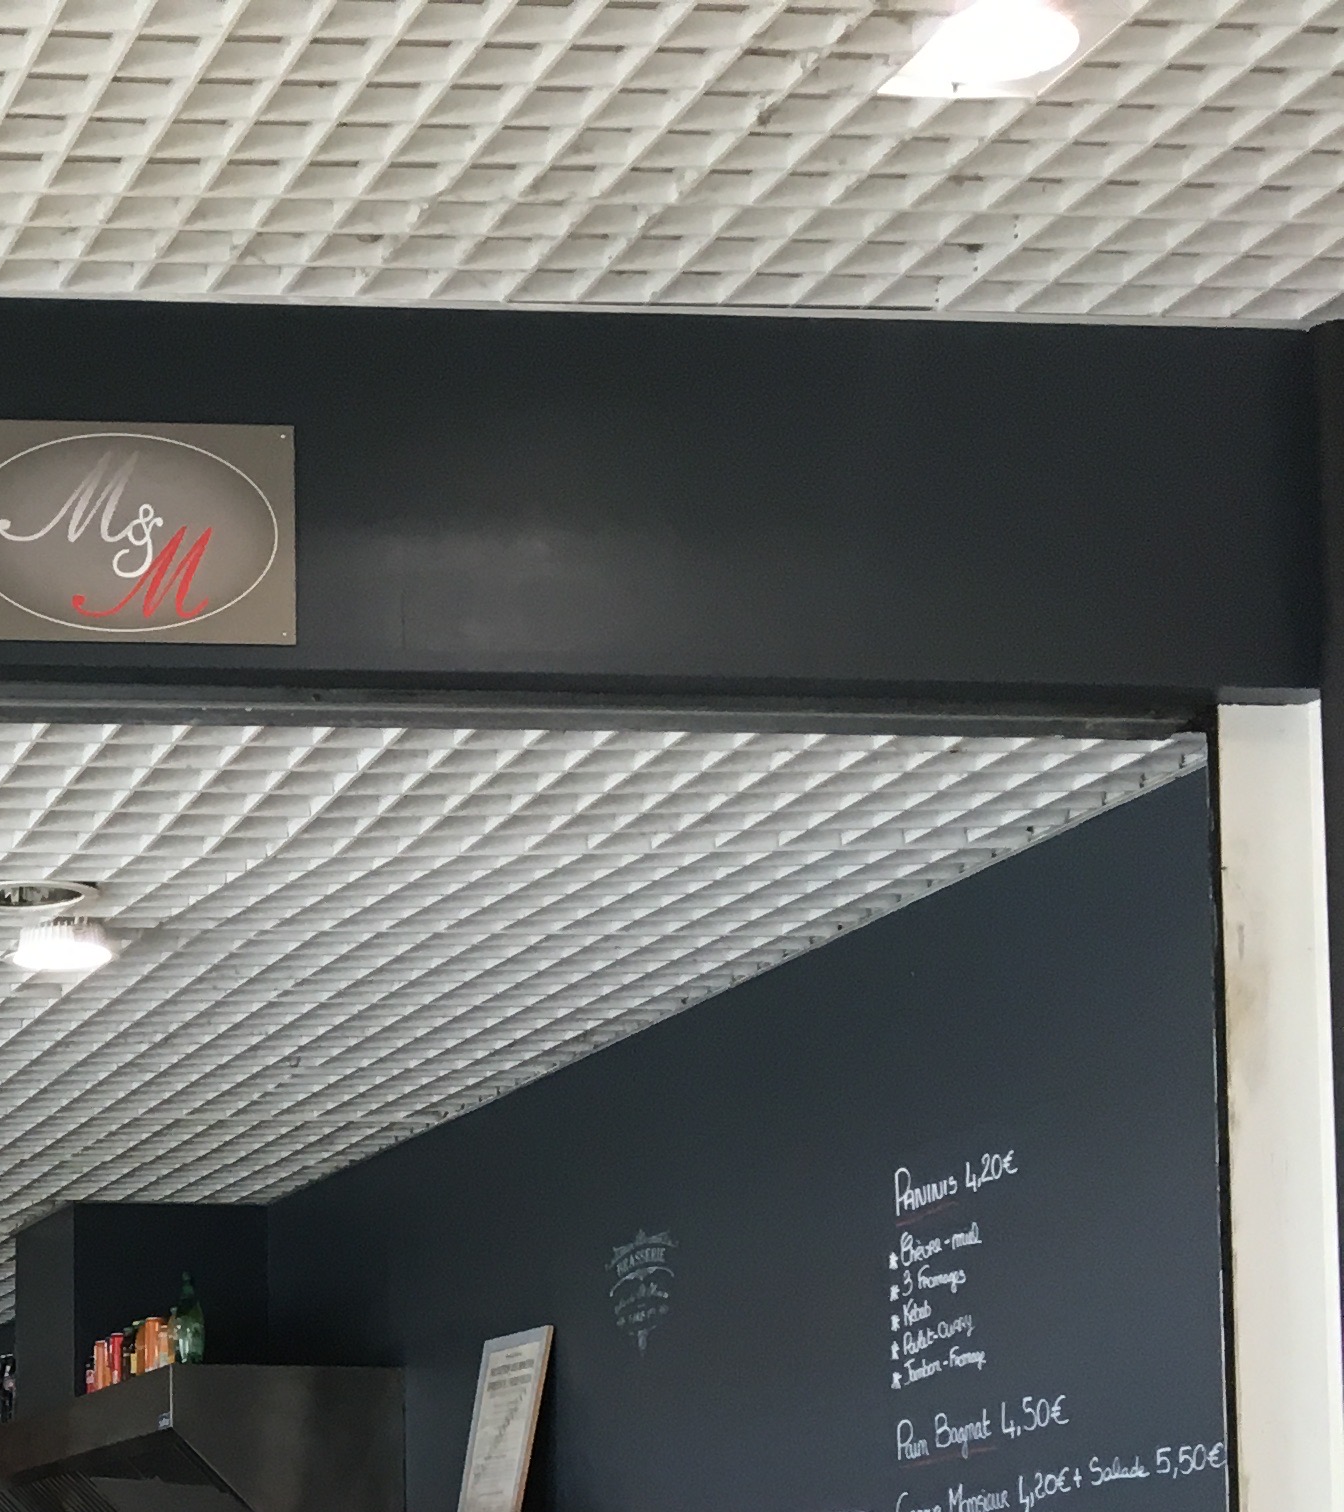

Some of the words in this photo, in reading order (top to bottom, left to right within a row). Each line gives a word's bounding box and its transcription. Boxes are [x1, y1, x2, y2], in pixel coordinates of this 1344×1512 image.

[966, 1150, 1018, 1191] 4,20€
[902, 1270, 912, 1296] 3
[897, 1419, 929, 1460] Pain
[934, 1409, 992, 1458] Bagnat
[1001, 1395, 1069, 1439] 4,50€
[1089, 1455, 1150, 1485] Salade
[1155, 1442, 1226, 1479] 5,50€
